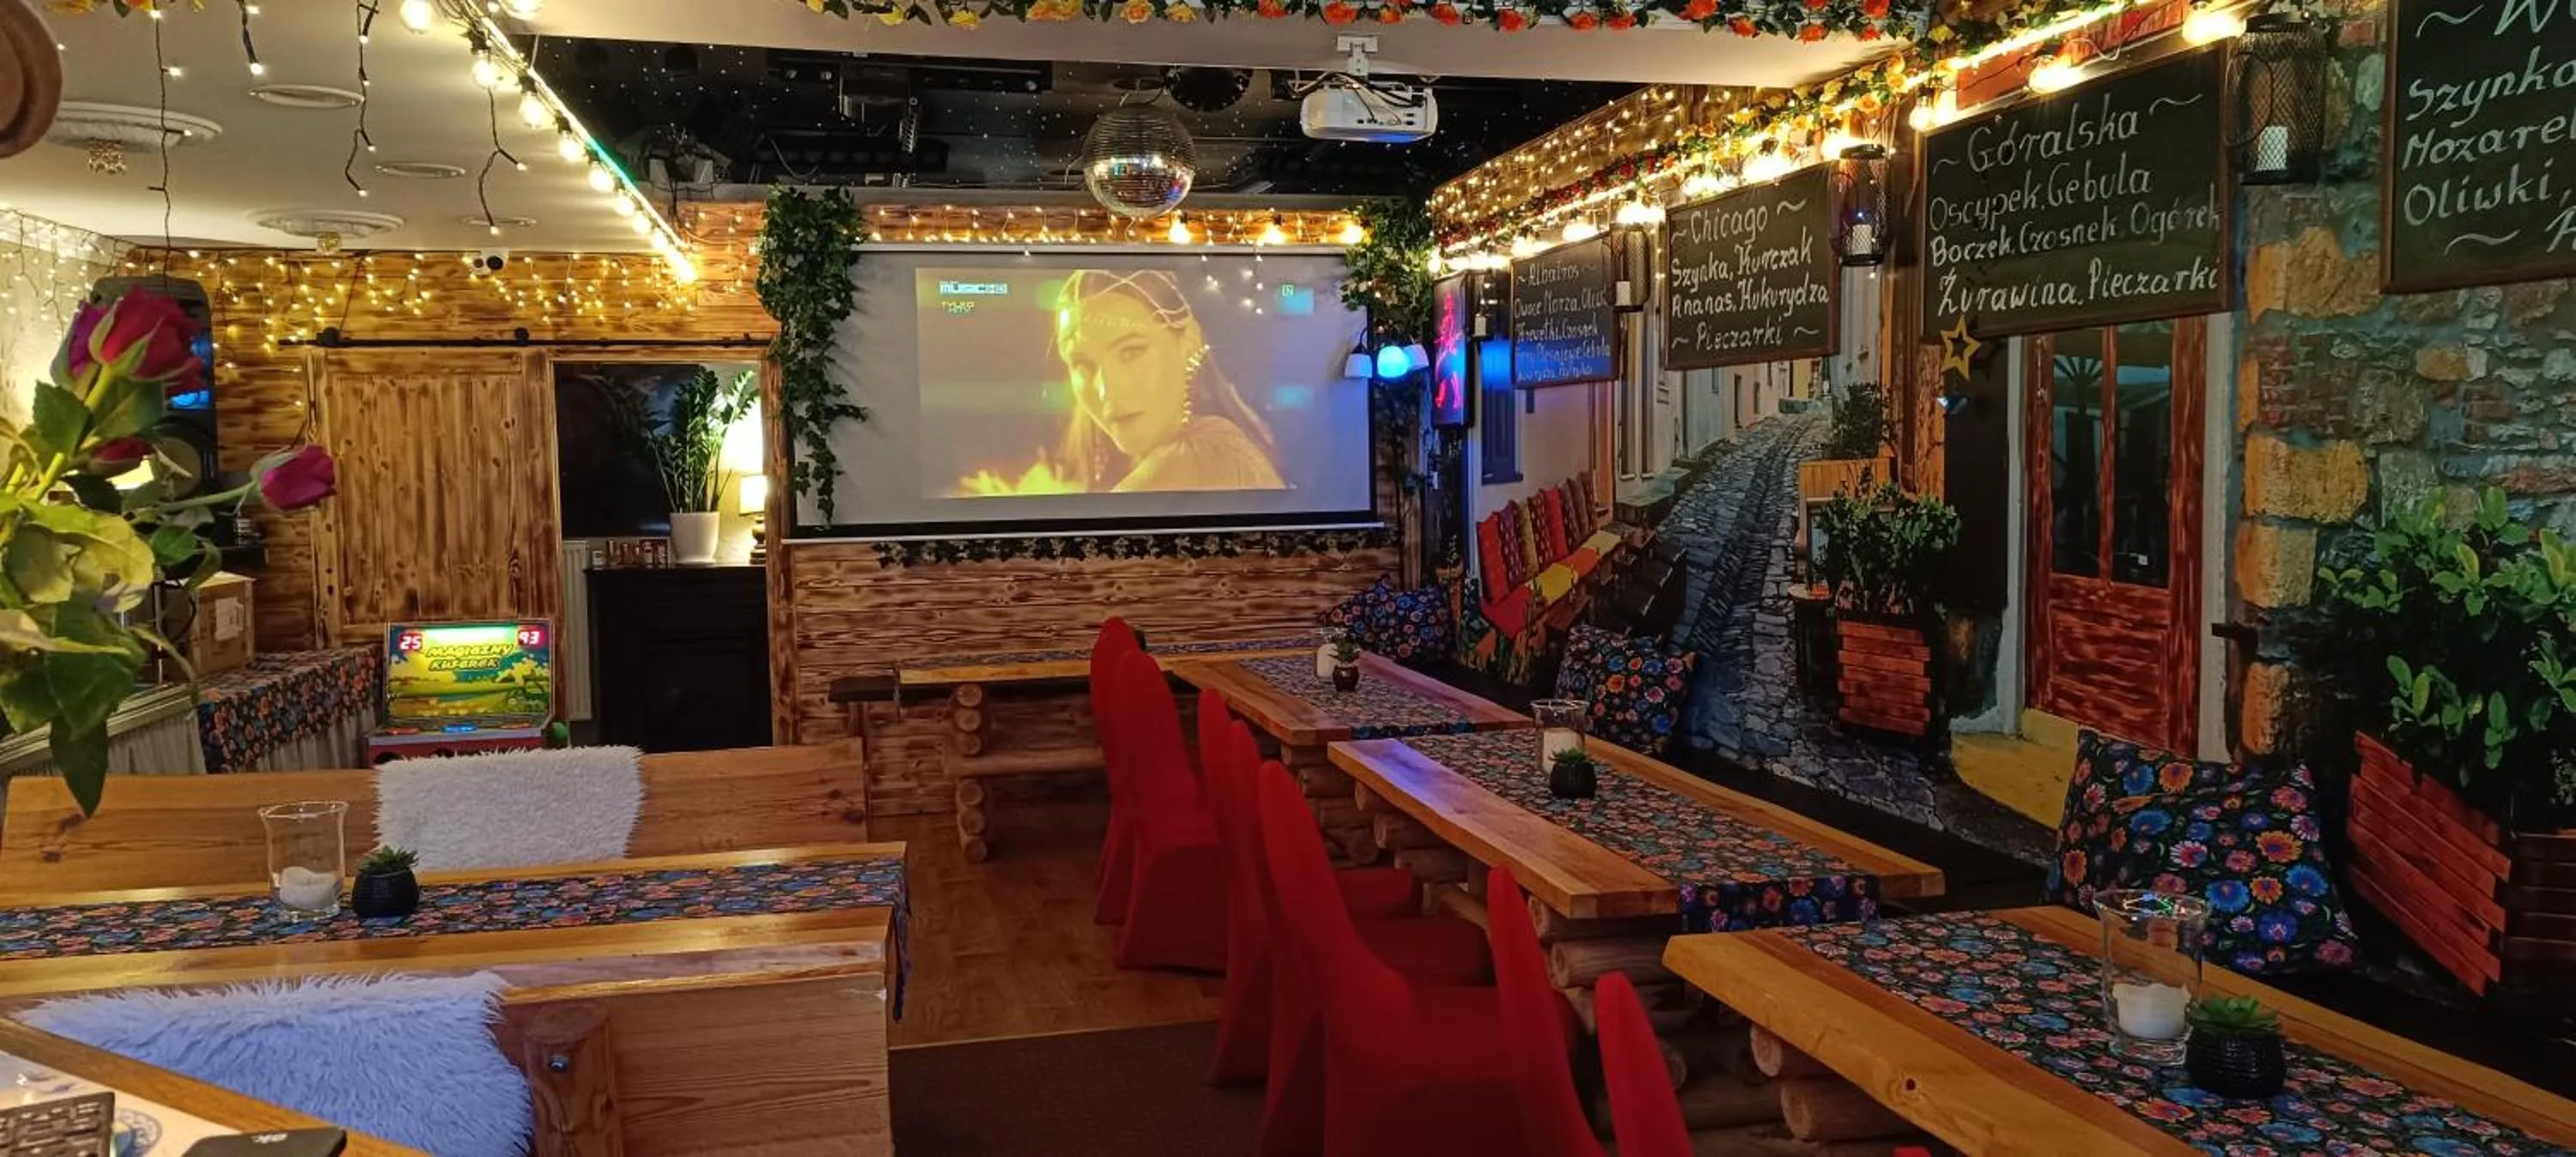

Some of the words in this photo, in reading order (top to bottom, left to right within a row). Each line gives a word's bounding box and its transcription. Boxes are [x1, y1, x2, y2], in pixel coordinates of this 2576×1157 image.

[1967, 93, 2139, 172] Góralska
[1691, 206, 1767, 245] Chicago
[400, 636, 422, 651] 25
[519, 631, 540, 645] 93
